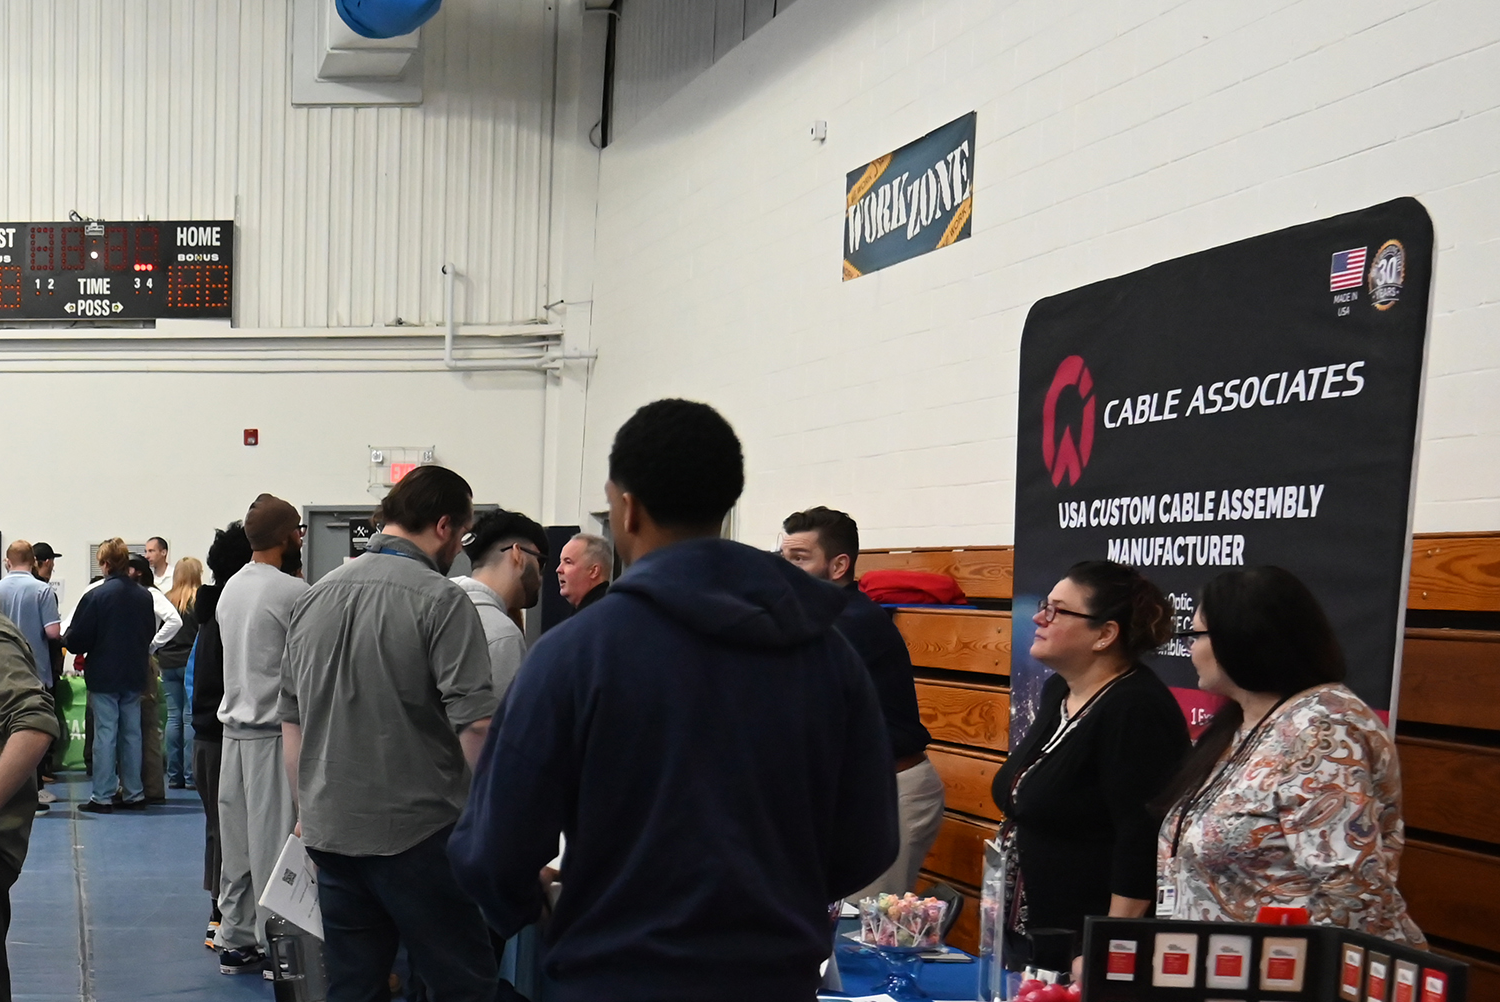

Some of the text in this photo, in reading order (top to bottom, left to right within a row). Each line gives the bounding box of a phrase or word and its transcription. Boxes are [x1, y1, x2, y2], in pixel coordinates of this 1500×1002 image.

[176, 226, 221, 246] HOME
[177, 253, 220, 261] BONUS
[1376, 256, 1397, 286] 30
[34, 278, 55, 289] 1 2
[77, 278, 111, 295] TIME
[134, 278, 153, 288] 3 4
[1333, 291, 1358, 304] MADE IN
[77, 299, 111, 316] POSS
[1337, 306, 1350, 317] USA
[1104, 360, 1366, 429] CABLE ASSOCIATES
[1058, 484, 1325, 529] USA CUSTOM CABLE ASSEMBLY
[1107, 534, 1245, 567] MANUFACTURER
